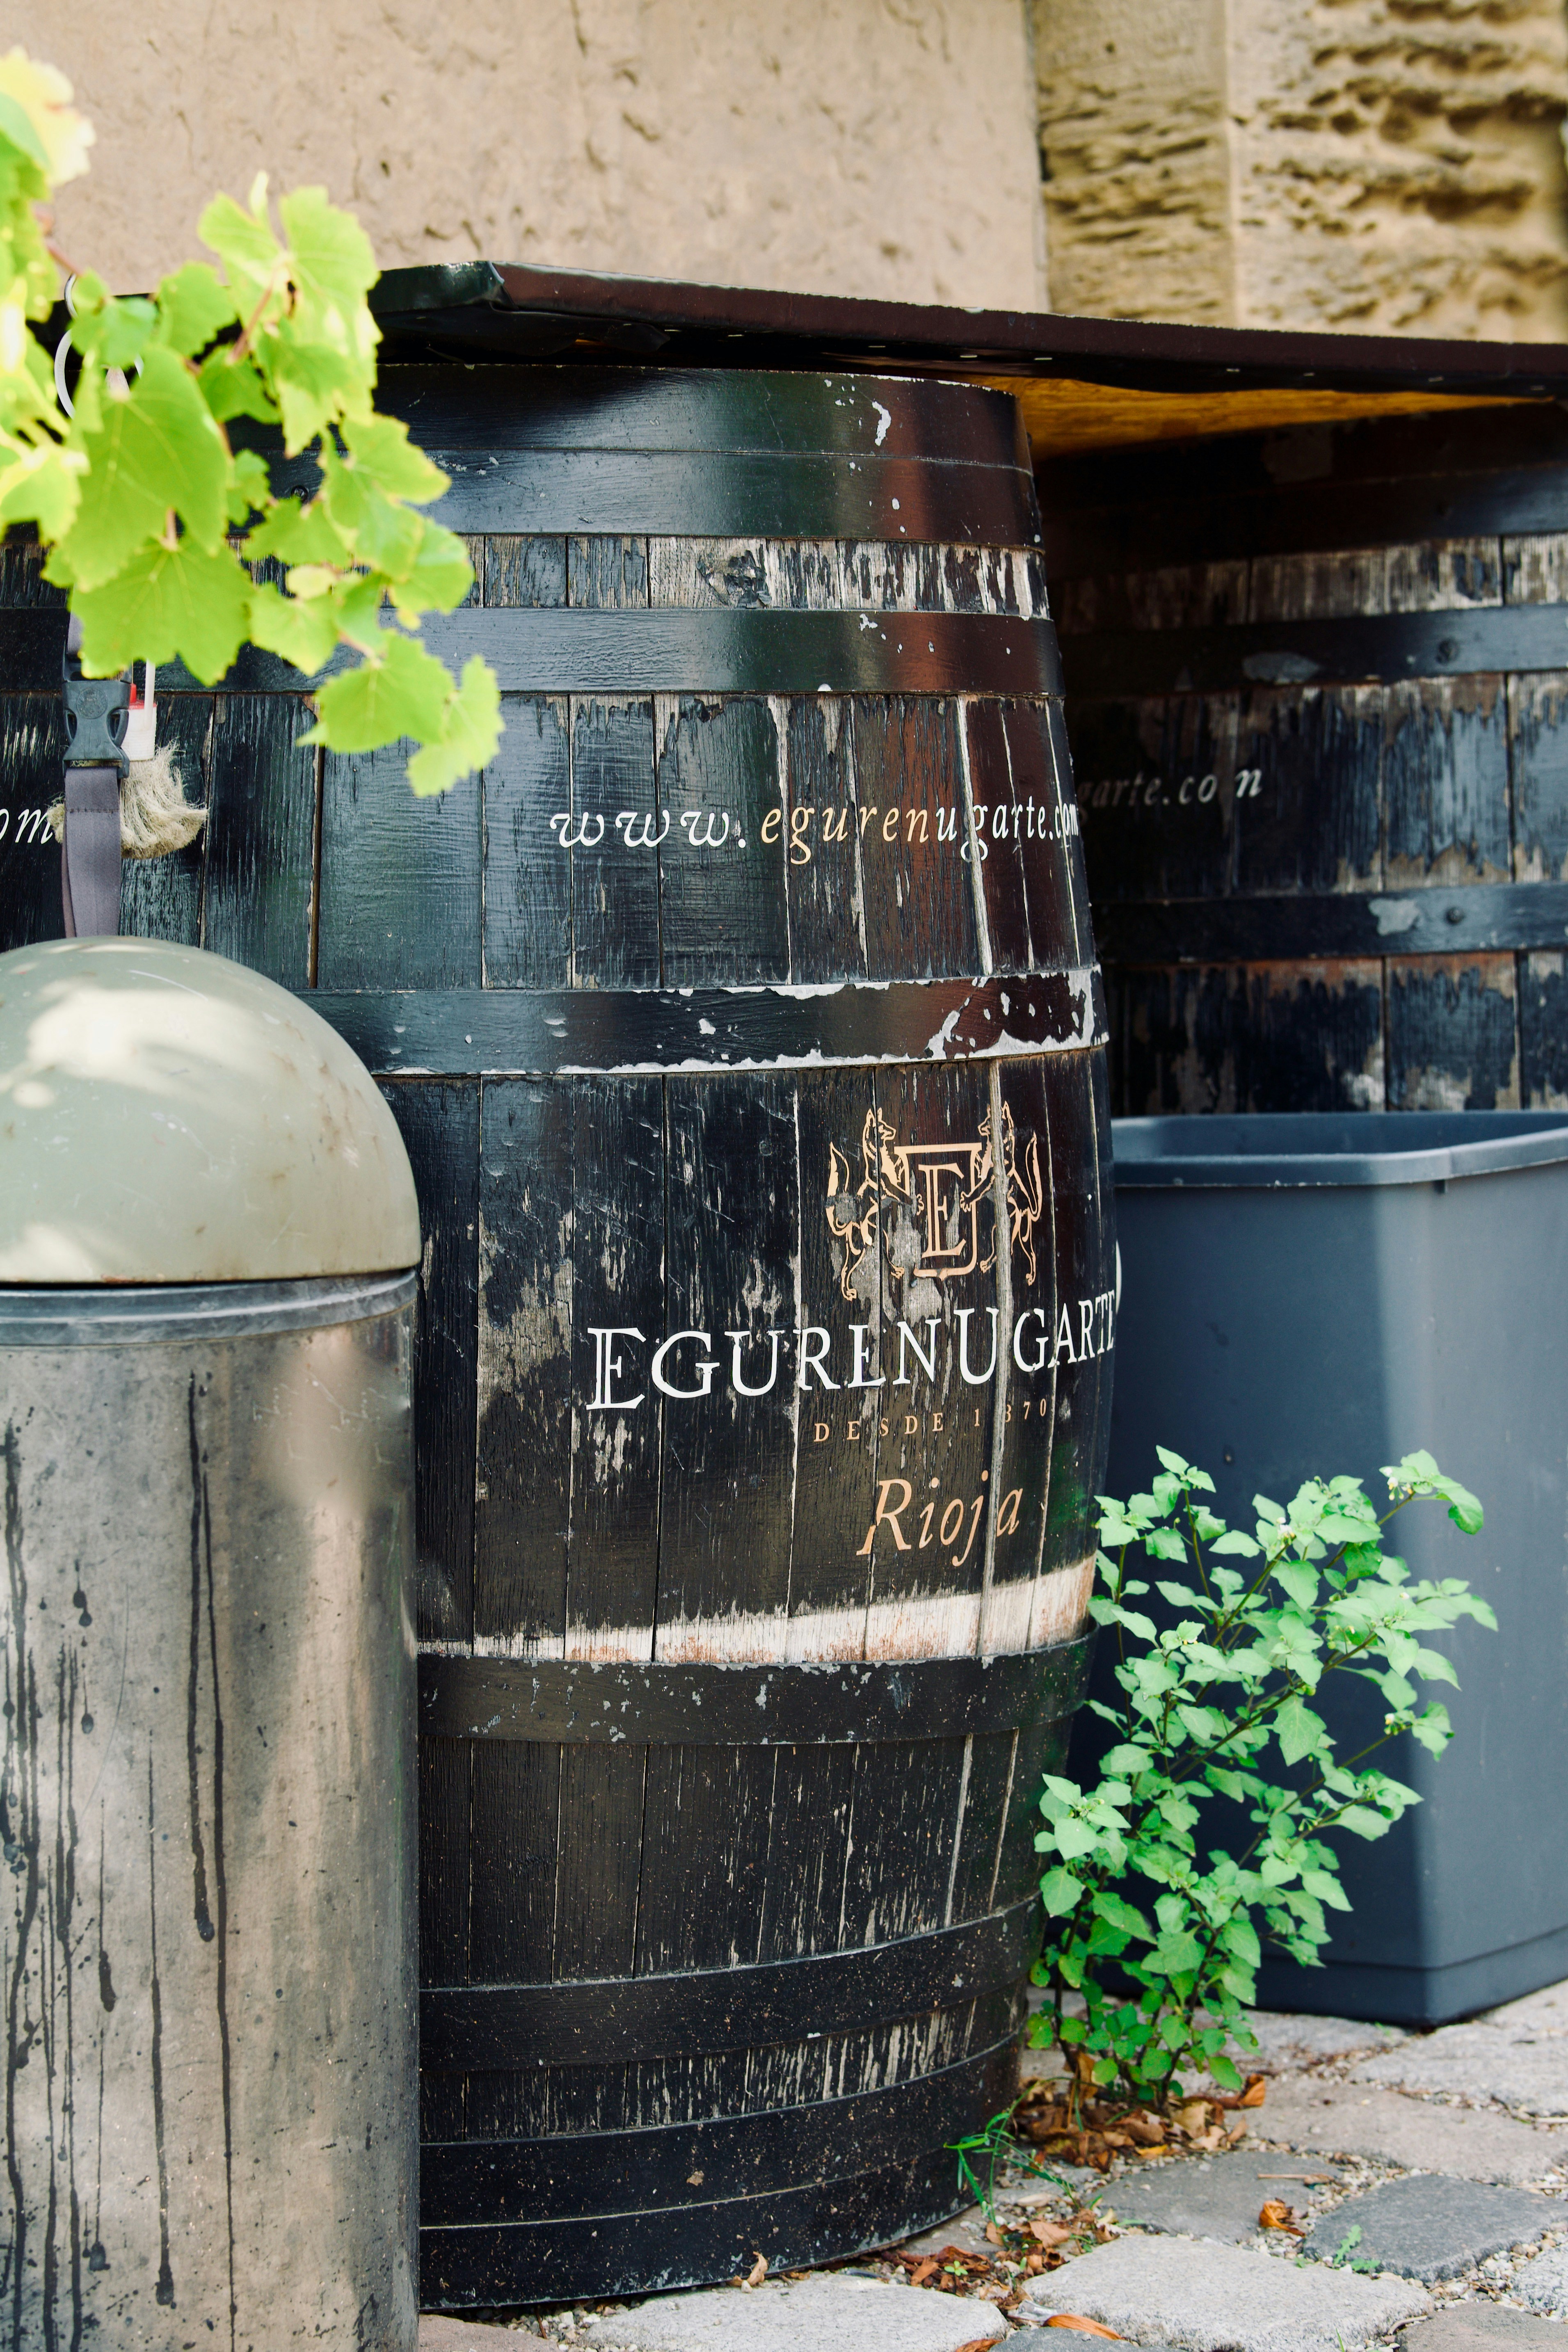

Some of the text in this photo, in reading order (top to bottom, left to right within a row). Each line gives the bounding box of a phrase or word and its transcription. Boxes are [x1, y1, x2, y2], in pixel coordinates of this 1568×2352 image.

[586, 1289, 1115, 1410] EGURENUGARTE
[814, 1412, 944, 1442] DESDE
[856, 1470, 1023, 1567] Rioja
